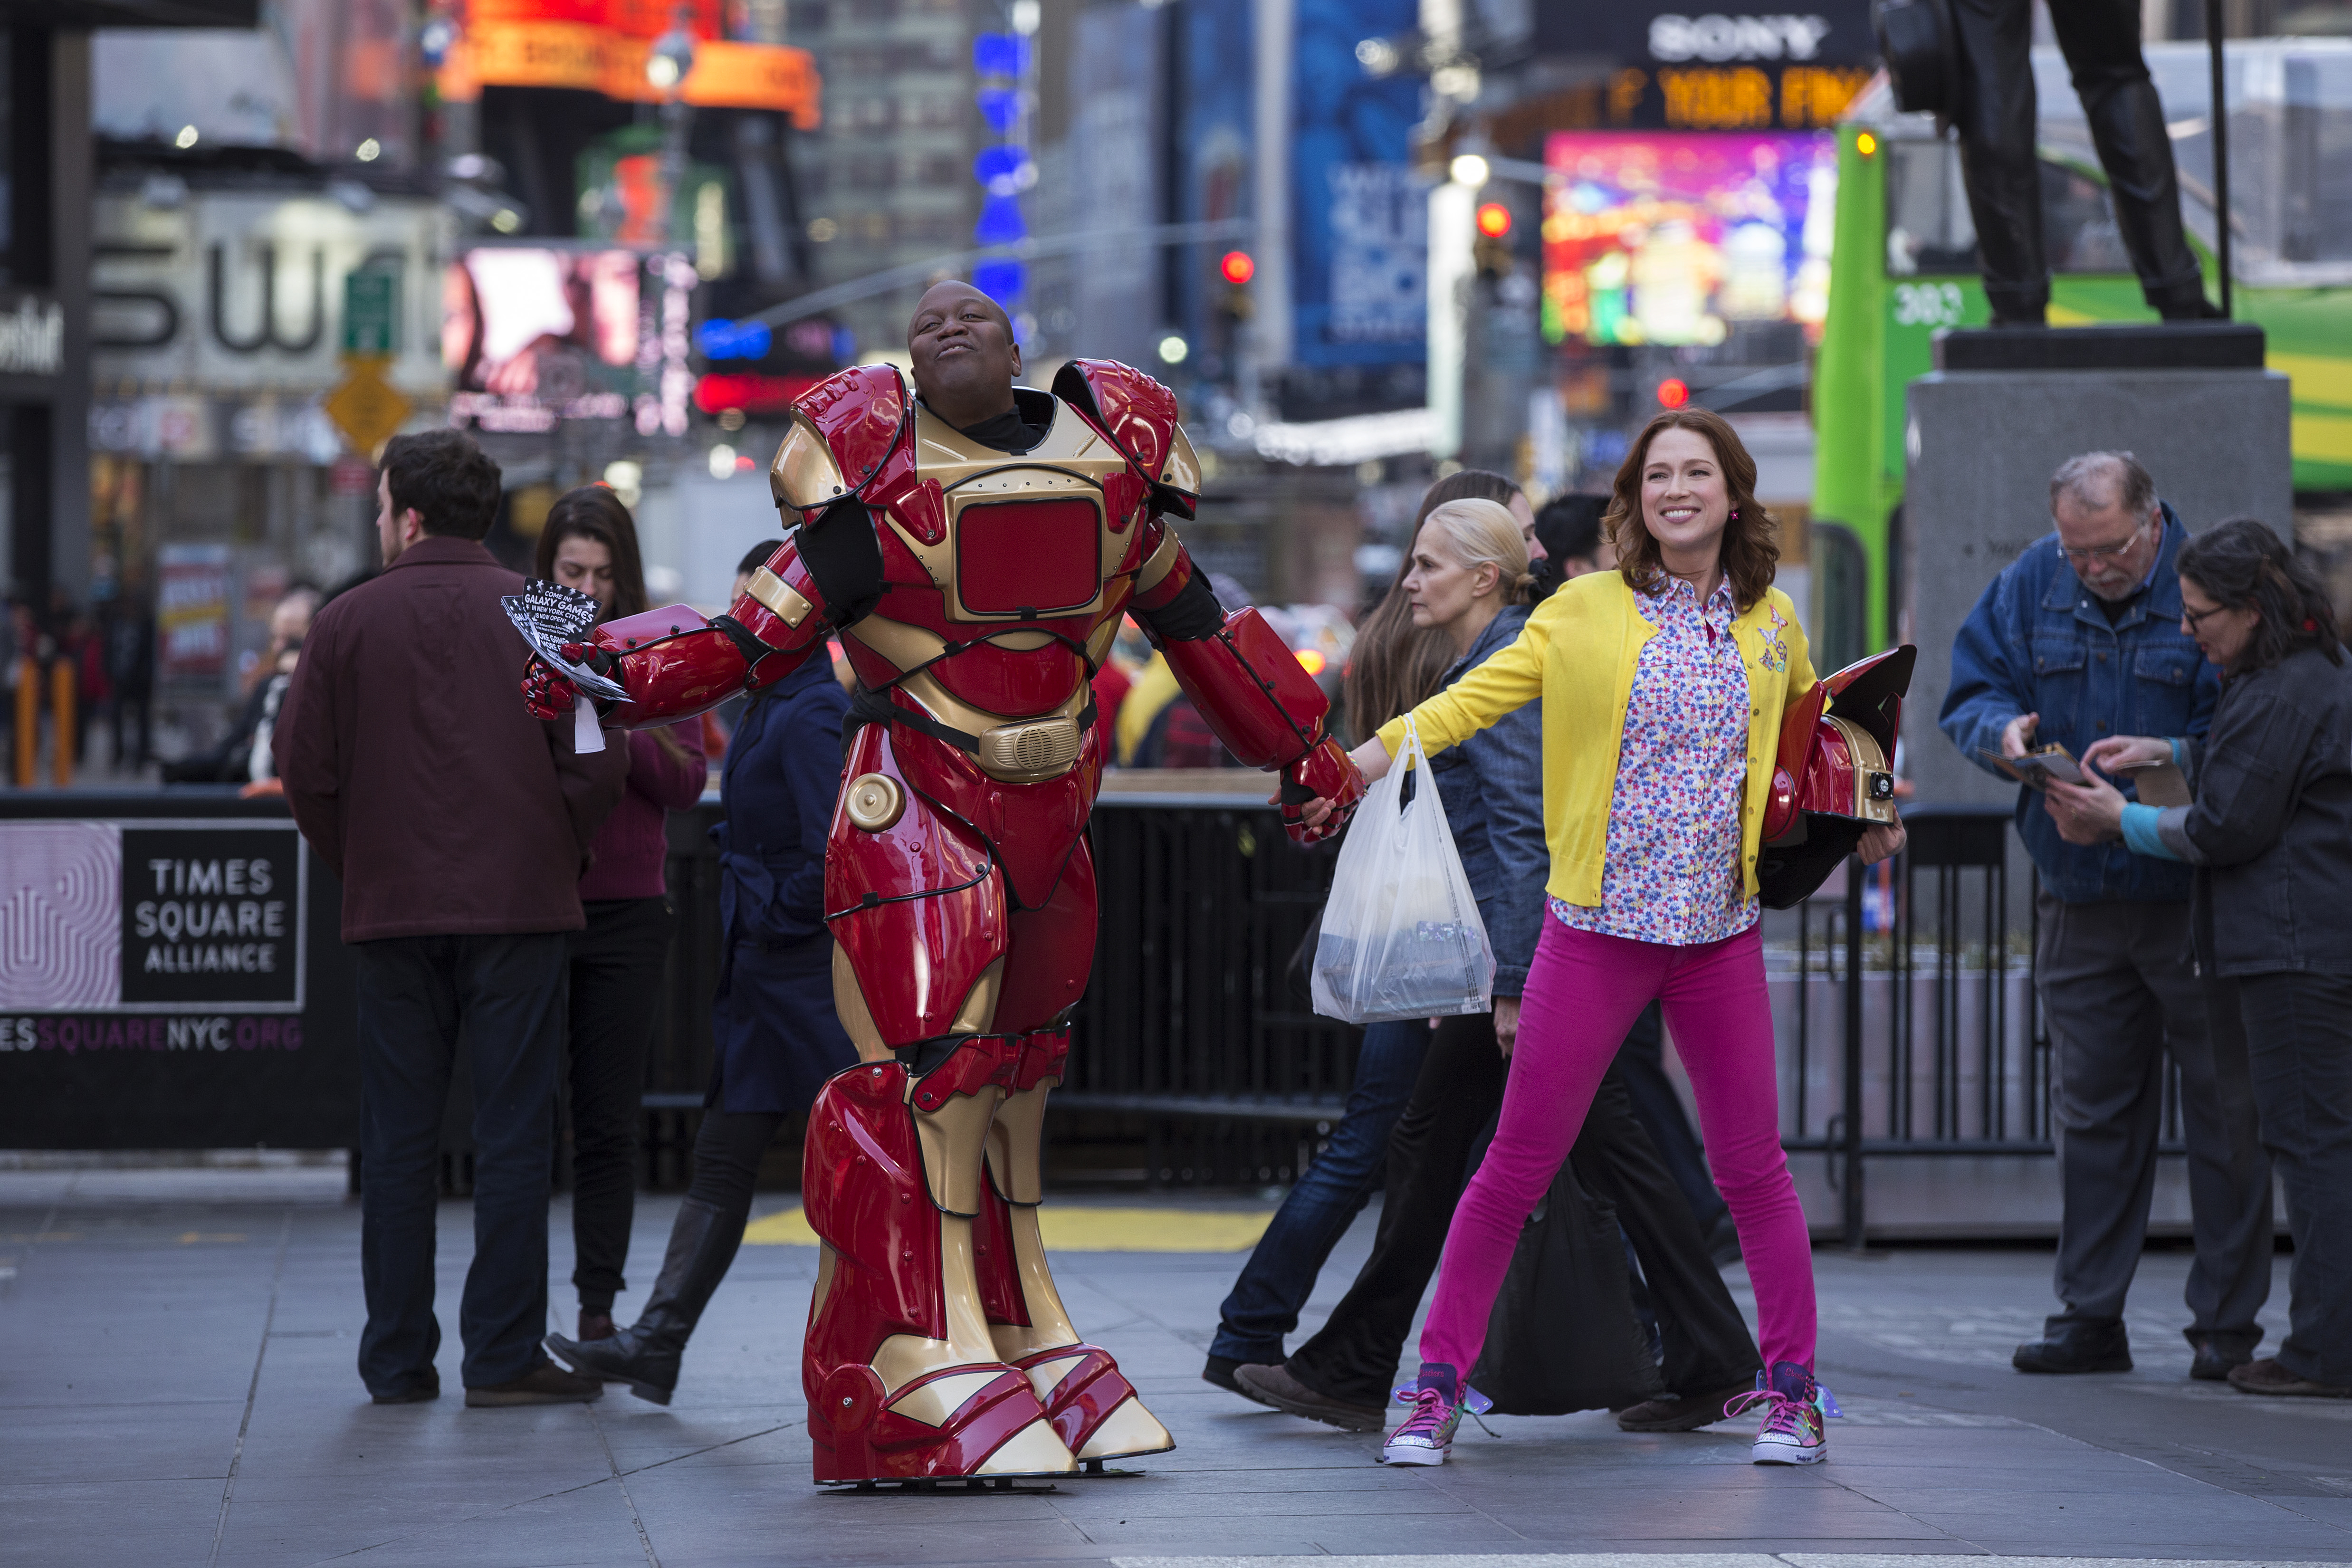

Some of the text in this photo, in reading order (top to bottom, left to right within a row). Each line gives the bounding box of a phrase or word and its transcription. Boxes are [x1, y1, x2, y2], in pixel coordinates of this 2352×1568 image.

[1648, 13, 1832, 62] SONY
[1657, 66, 1773, 129] YOUR
[525, 593, 594, 622] GALAXY GAMES
[545, 591, 562, 599] COME
[549, 607, 564, 616] YORK
[564, 612, 580, 621] CITY
[550, 615, 566, 623] OPEN!
[538, 631, 550, 641] ORE
[148, 858, 273, 895] TIMES
[135, 901, 285, 942] SQUARE
[144, 944, 277, 973] ALLIANCE
[0, 1018, 302, 1055] ESSQUARENYC.ORG
